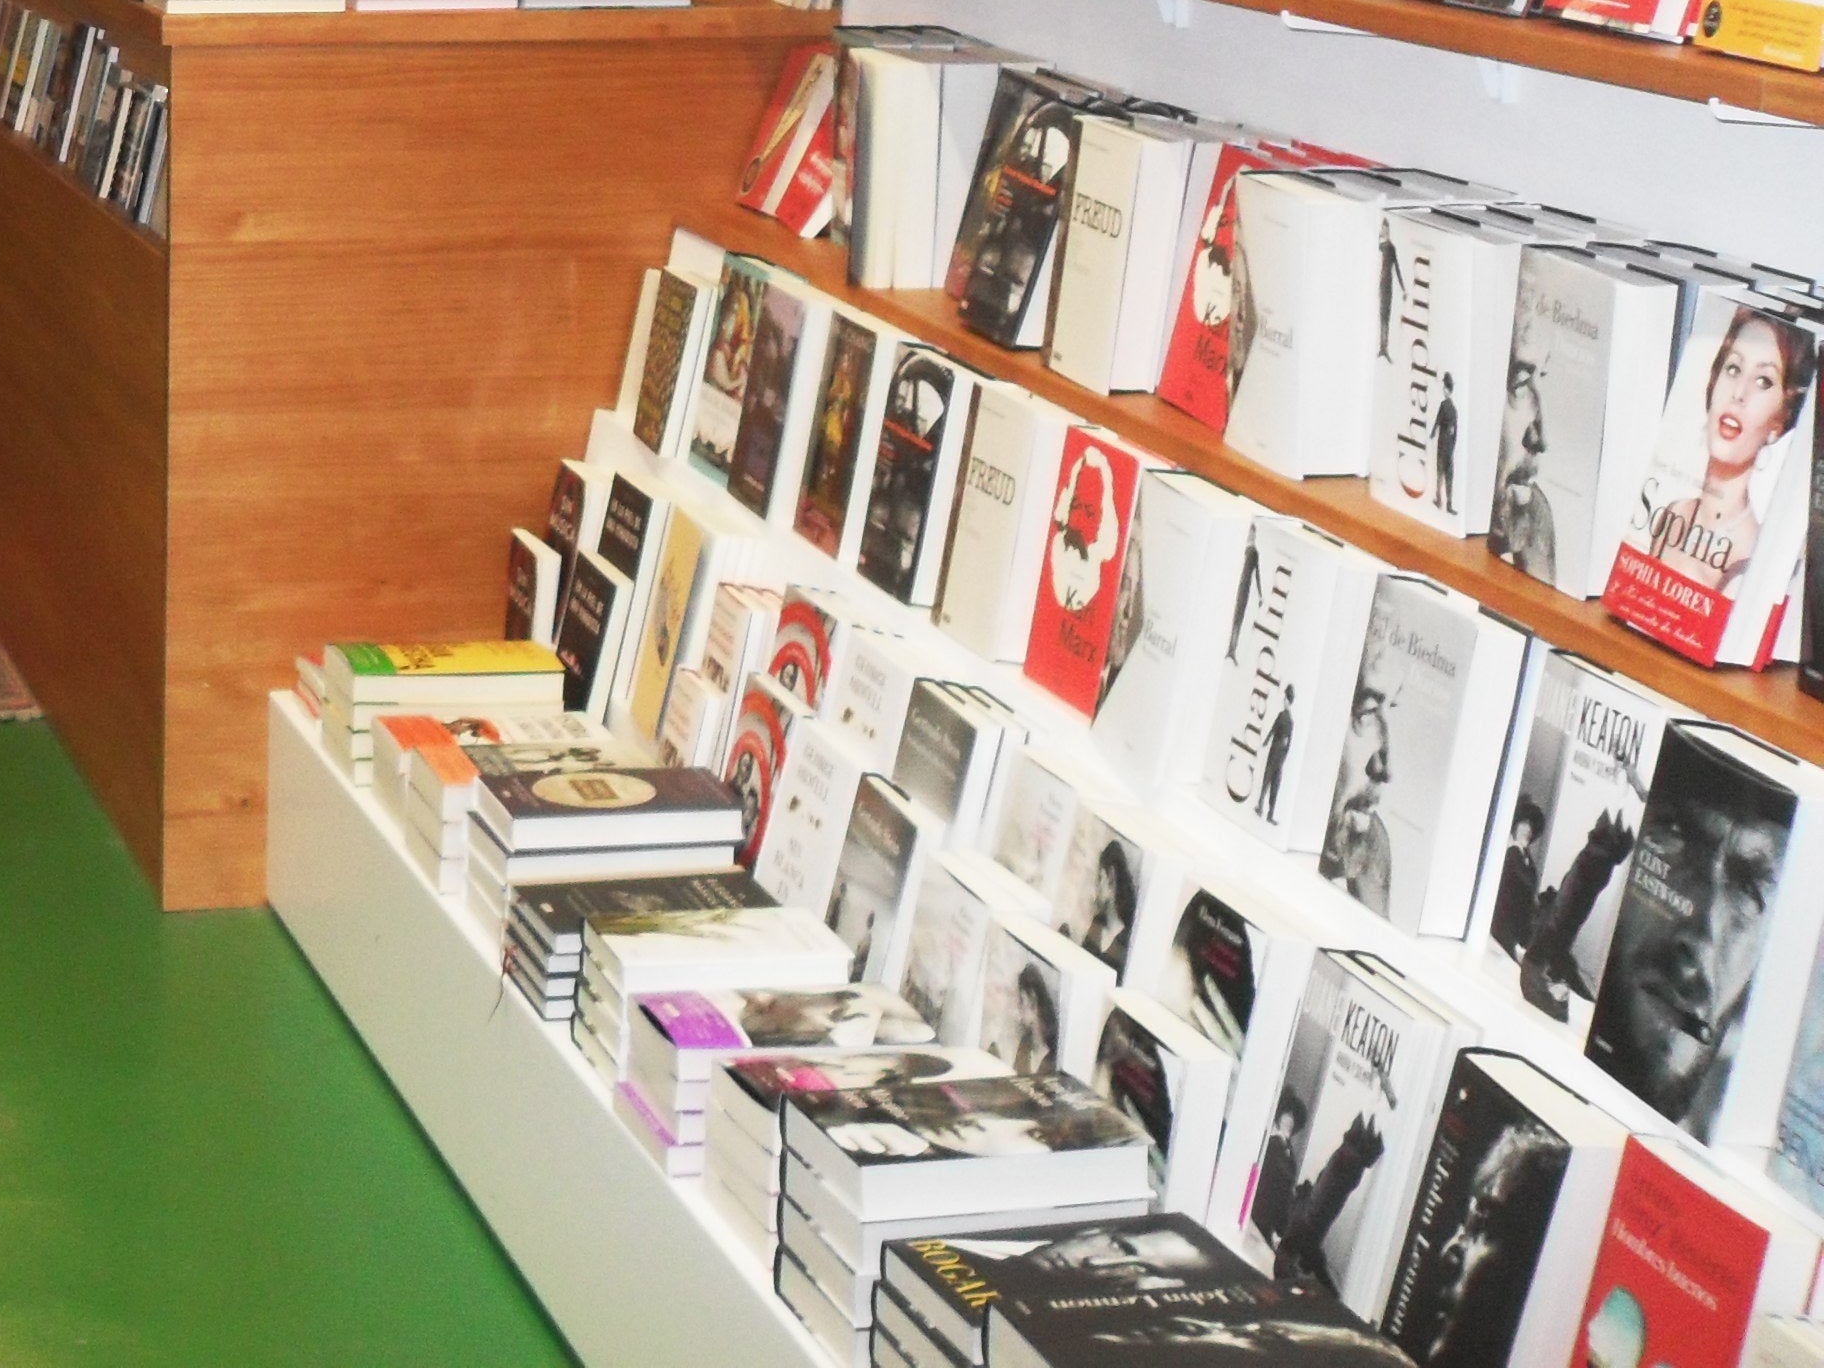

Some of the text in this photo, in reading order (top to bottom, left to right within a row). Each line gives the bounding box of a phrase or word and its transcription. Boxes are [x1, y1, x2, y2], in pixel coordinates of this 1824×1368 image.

[1074, 192, 1122, 238] FREUD
[1397, 253, 1438, 500] Chaplin
[971, 456, 1016, 506] FREUD
[1630, 476, 1734, 575] Sophia
[1620, 552, 1716, 618] SOPHIA LOREN
[1226, 563, 1294, 804] Chaplin
[1389, 624, 1406, 650] de
[1406, 635, 1457, 680] Biedma
[1578, 694, 1647, 769] KEATON
[1635, 866, 1694, 919] EASTWOOD
[1640, 850, 1673, 881] CLINT
[1340, 999, 1401, 1076] KEATON
[1421, 1156, 1452, 1225] John
[907, 1239, 1000, 1308] BOGAR
[1049, 1287, 1231, 1310] John Lennon
